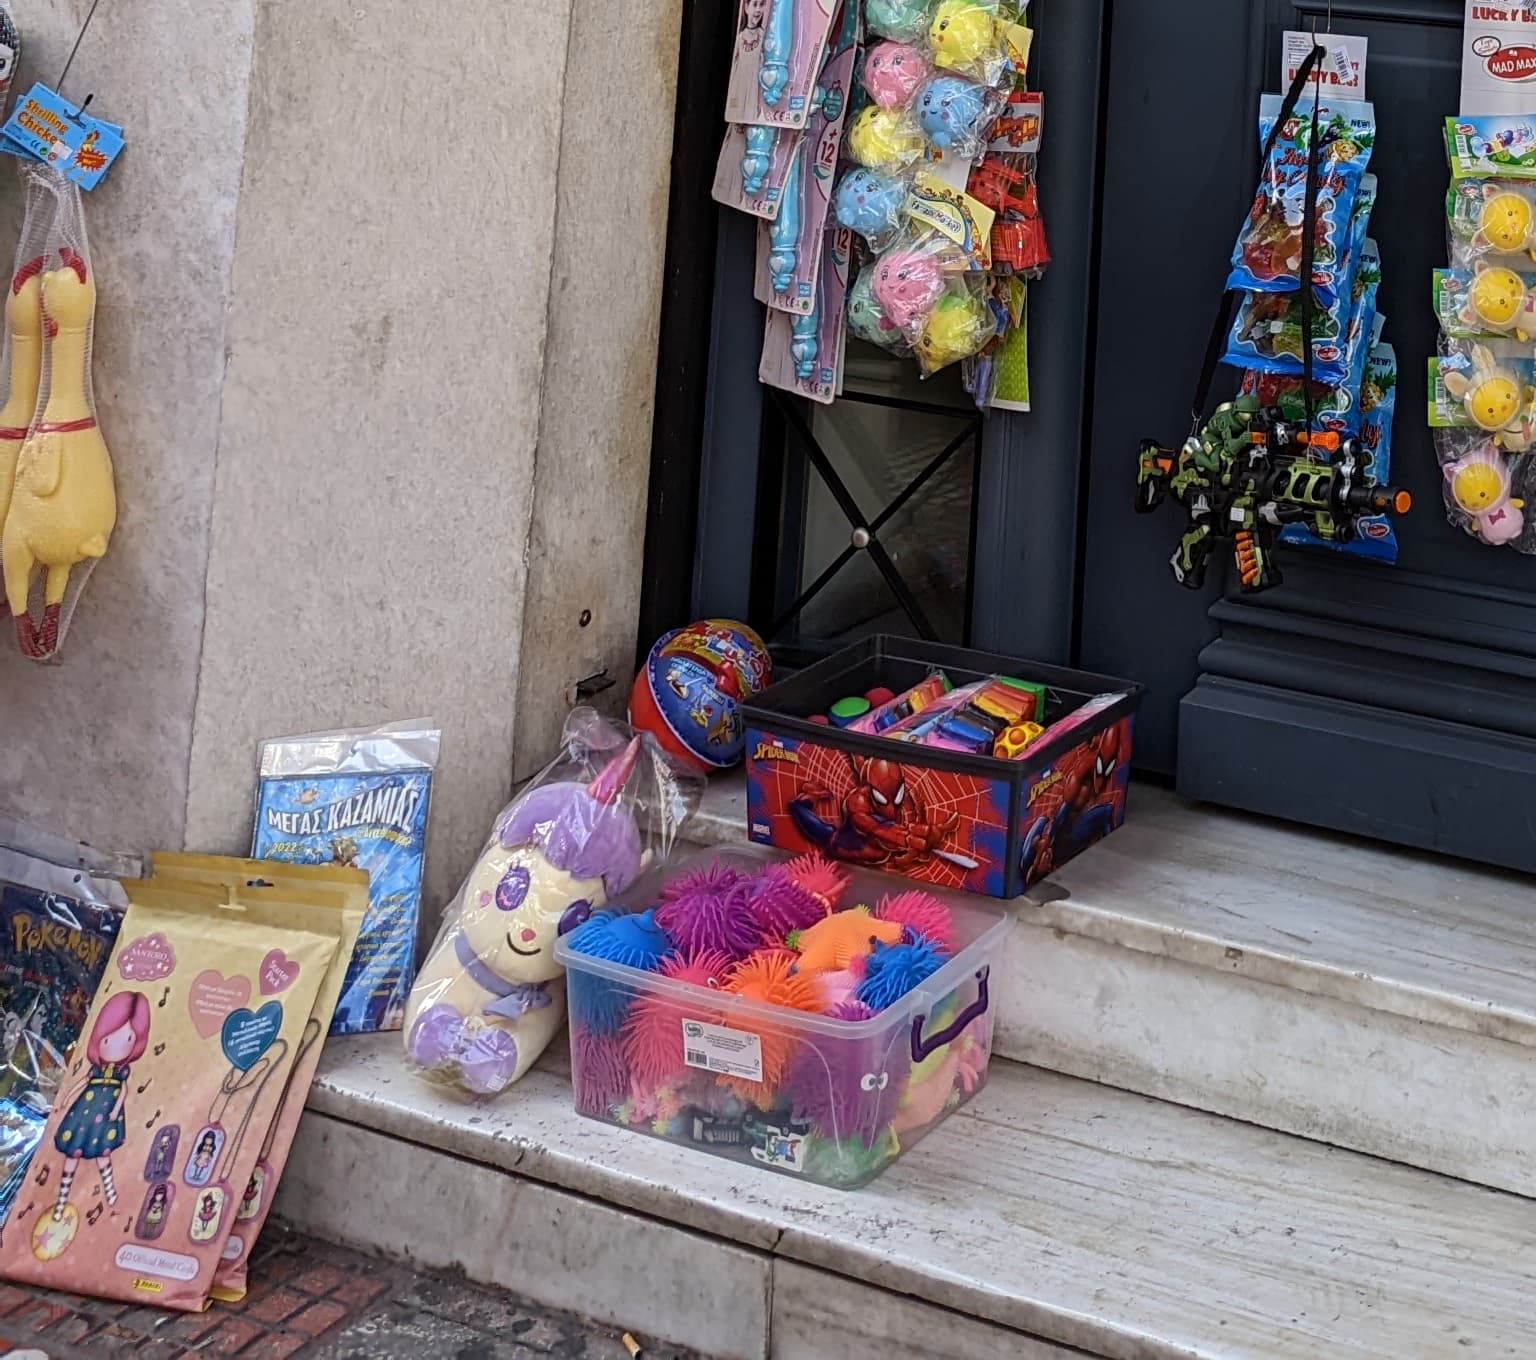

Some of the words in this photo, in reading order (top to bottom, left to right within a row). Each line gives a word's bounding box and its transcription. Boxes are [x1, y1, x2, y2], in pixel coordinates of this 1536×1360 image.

[1491, 60, 1515, 74] MAD
[17, 111, 66, 147] Chicke
[820, 140, 836, 164] 12
[267, 806, 323, 834] ΜΕΓΑΣ
[327, 785, 419, 834] ΚΑΖΑΜΙΑΣ
